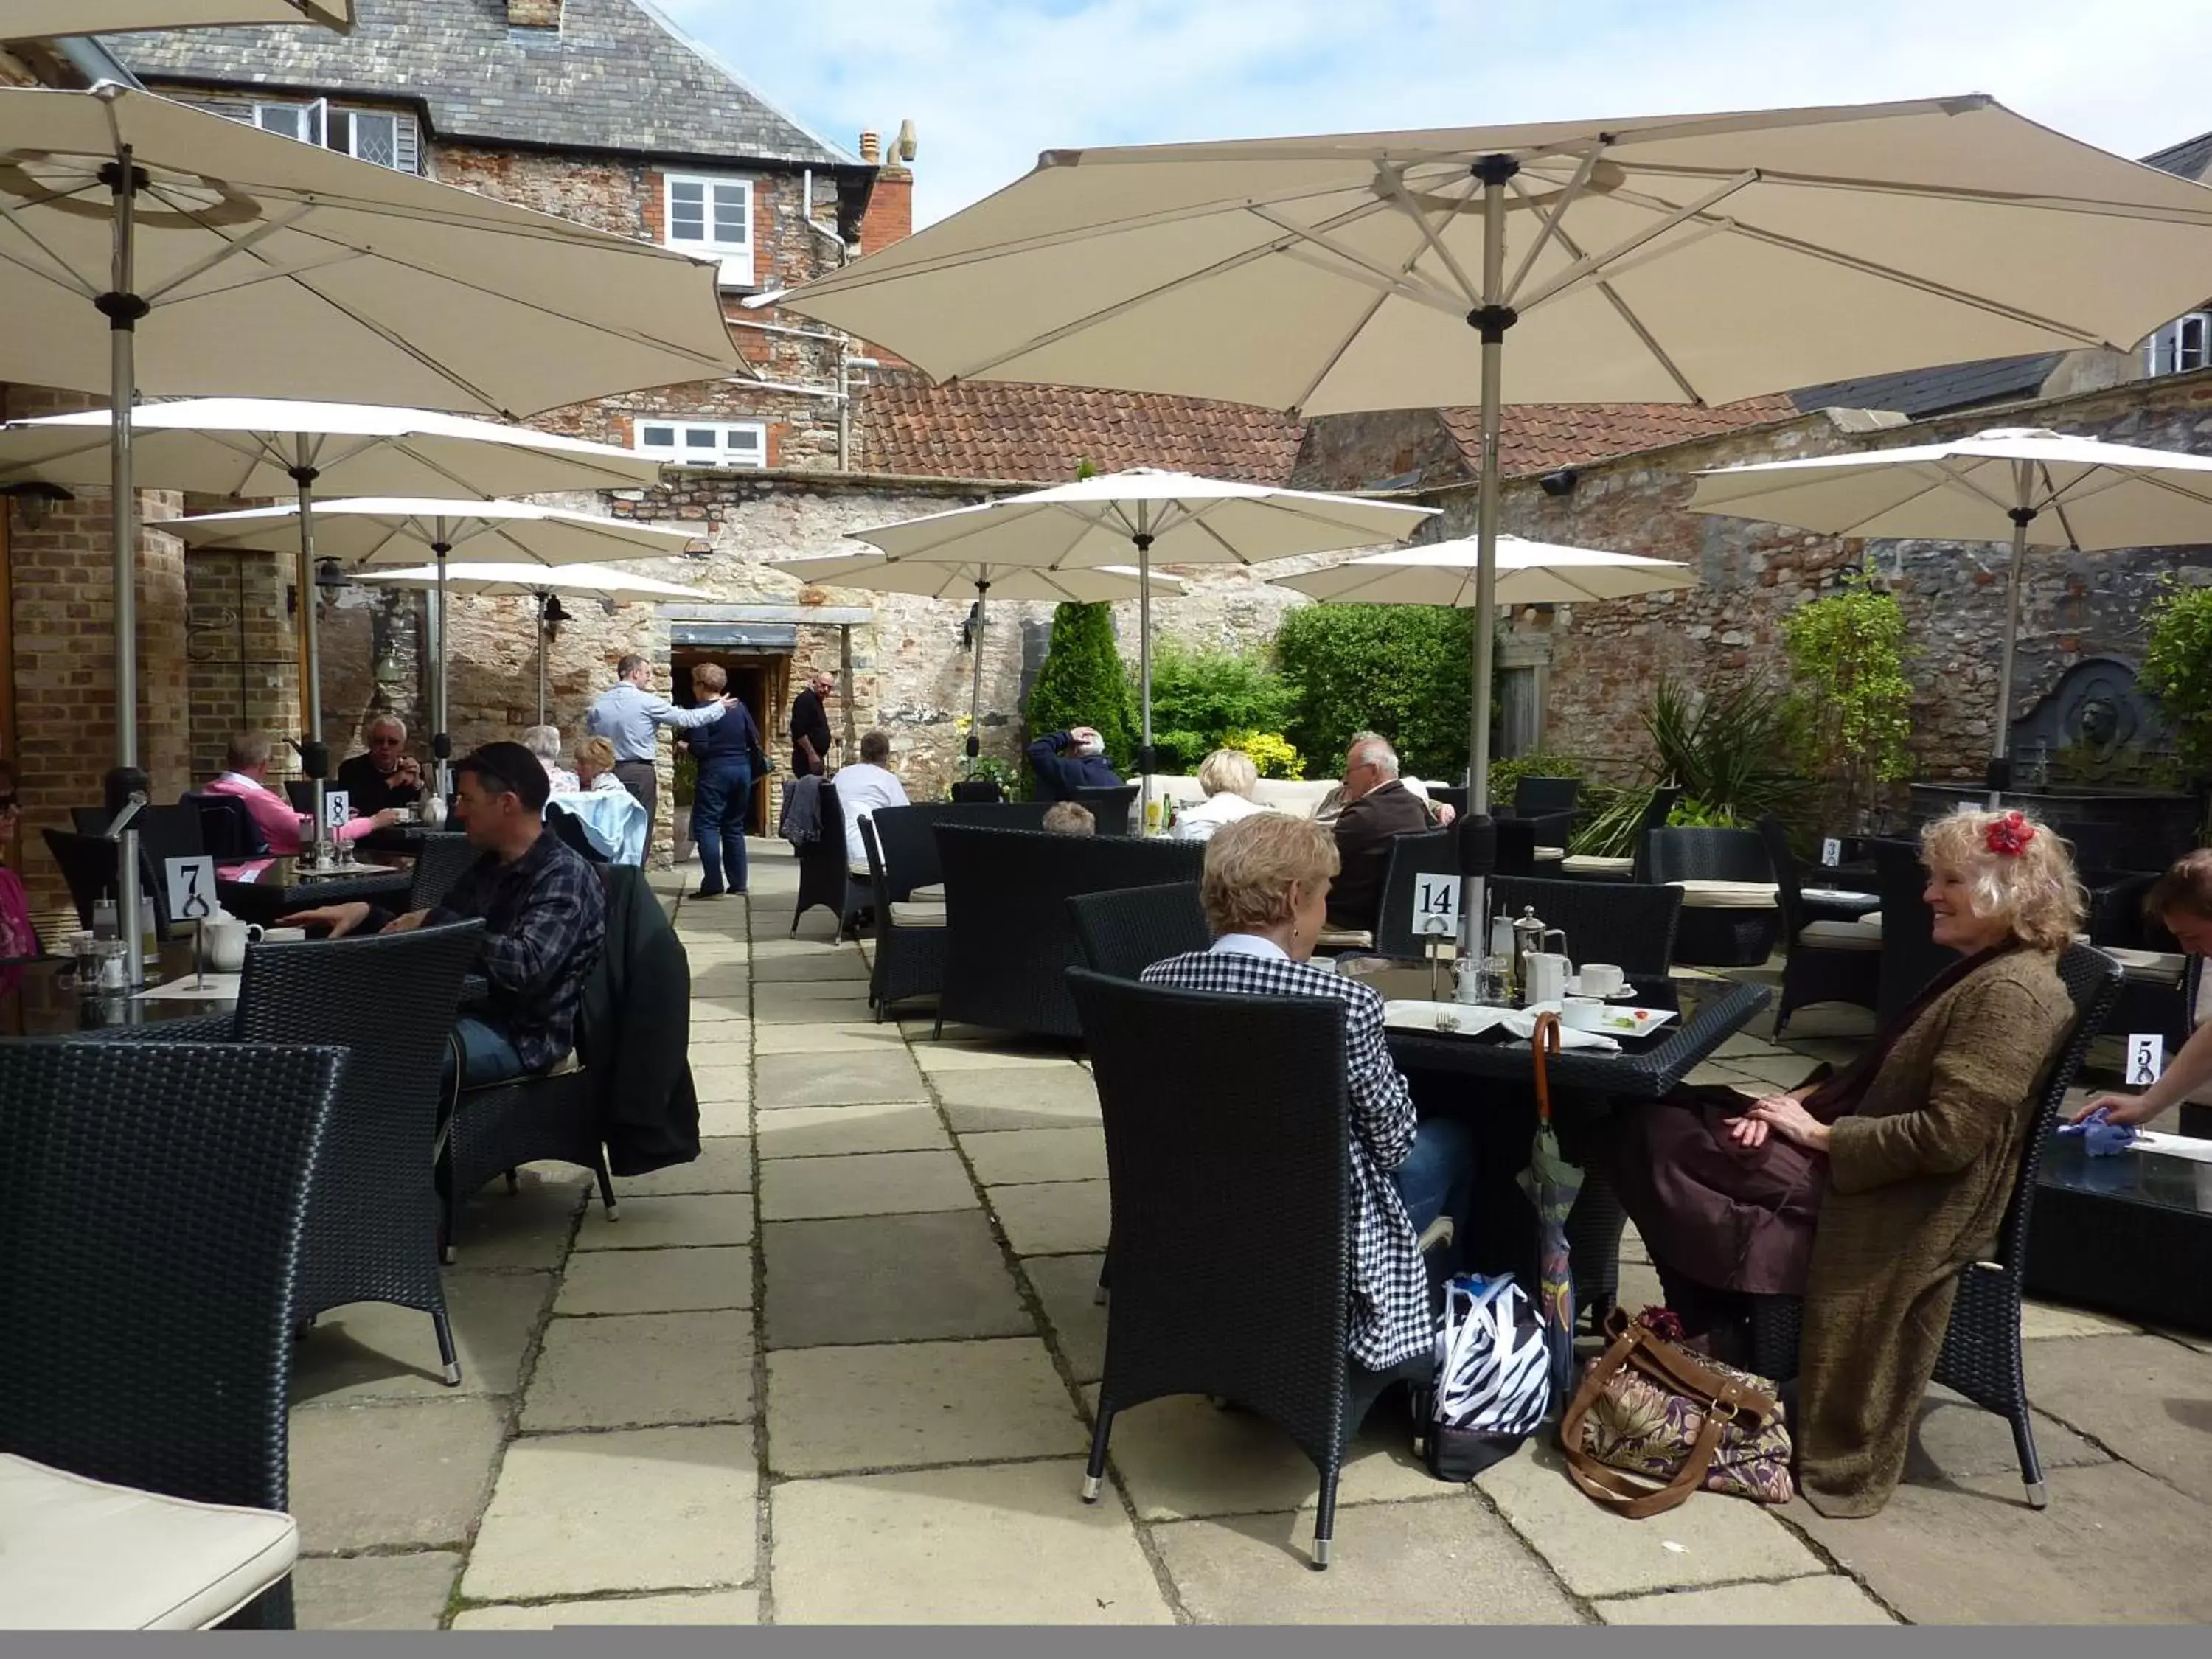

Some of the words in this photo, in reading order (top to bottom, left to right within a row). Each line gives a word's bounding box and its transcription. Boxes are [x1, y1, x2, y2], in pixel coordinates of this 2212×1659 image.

[334, 796, 343, 815] 8
[181, 864, 199, 894] 7
[1420, 883, 1452, 914] 14
[2138, 1040, 2152, 1065] 5
